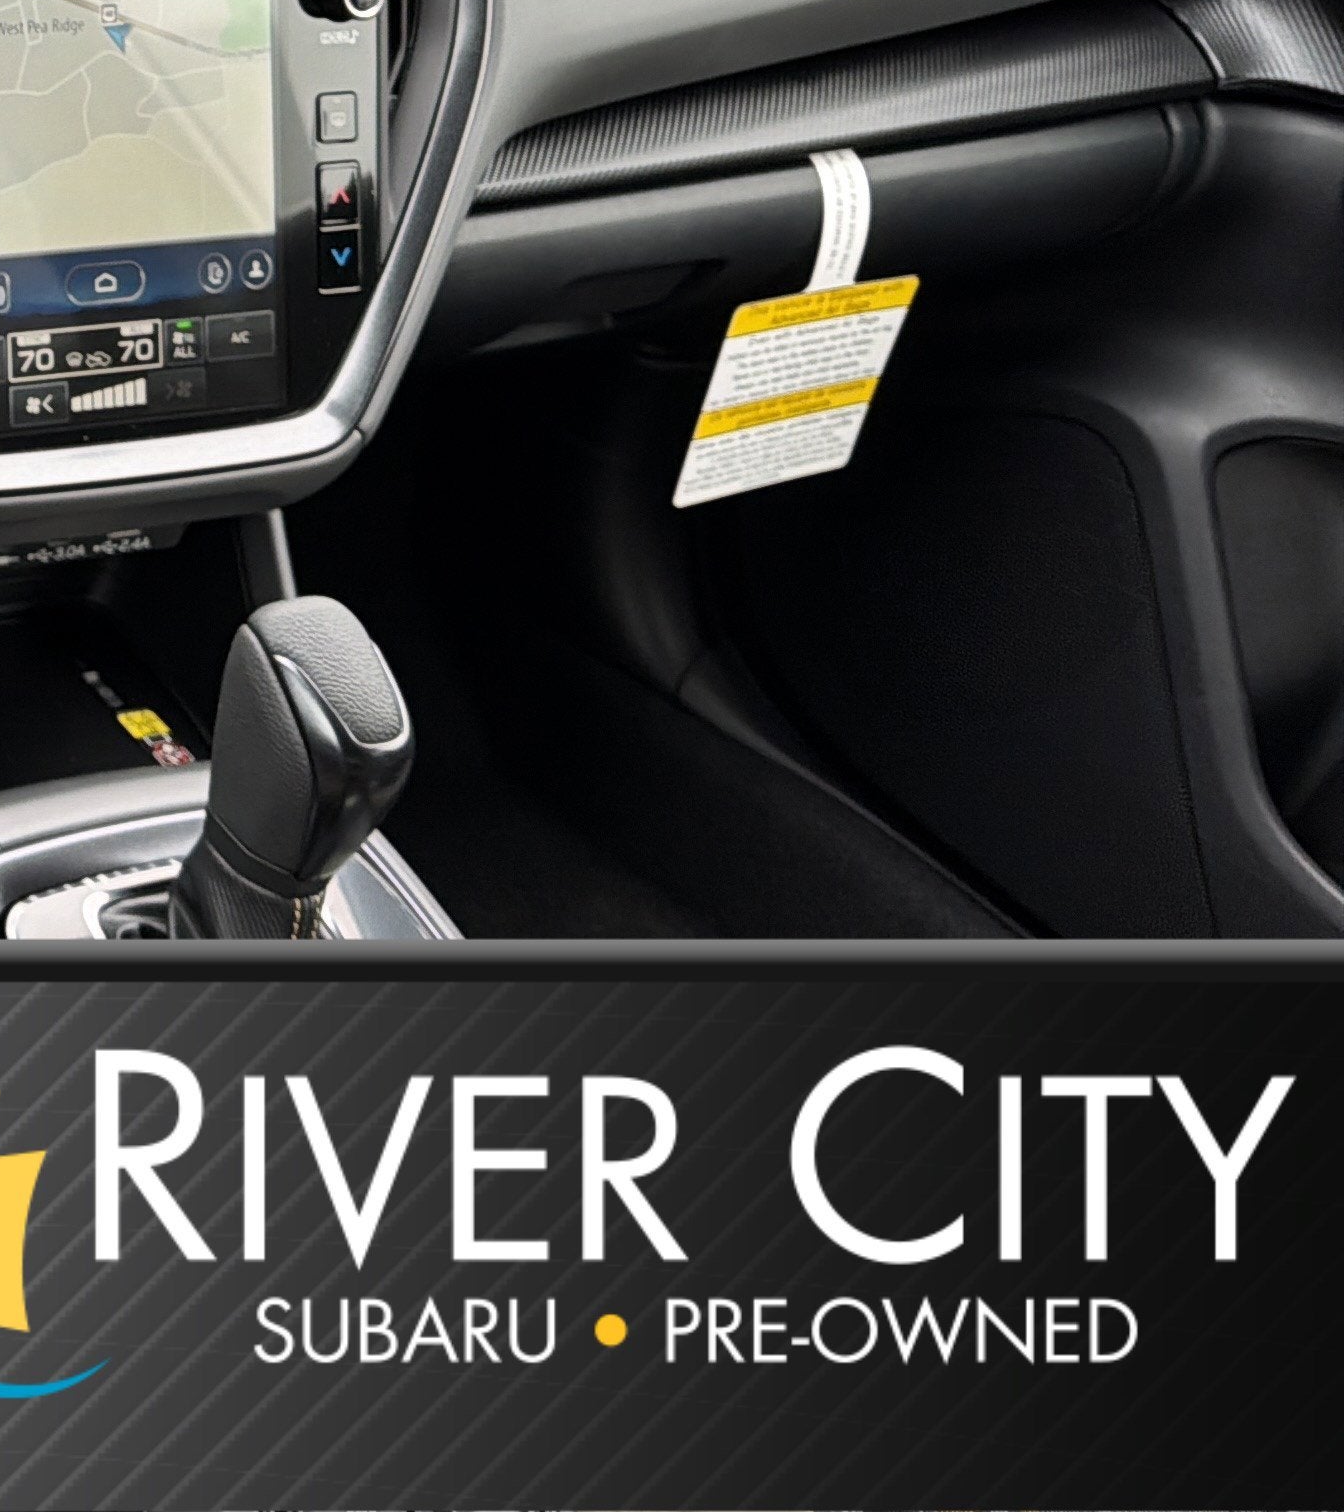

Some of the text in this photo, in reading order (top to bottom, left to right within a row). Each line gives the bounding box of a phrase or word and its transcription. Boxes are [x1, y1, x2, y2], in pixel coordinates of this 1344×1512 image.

[27, 21, 48, 34] Pea
[52, 19, 85, 35] Ridge
[118, 338, 154, 362] 70
[173, 345, 196, 358] ALL
[17, 349, 54, 372] 70
